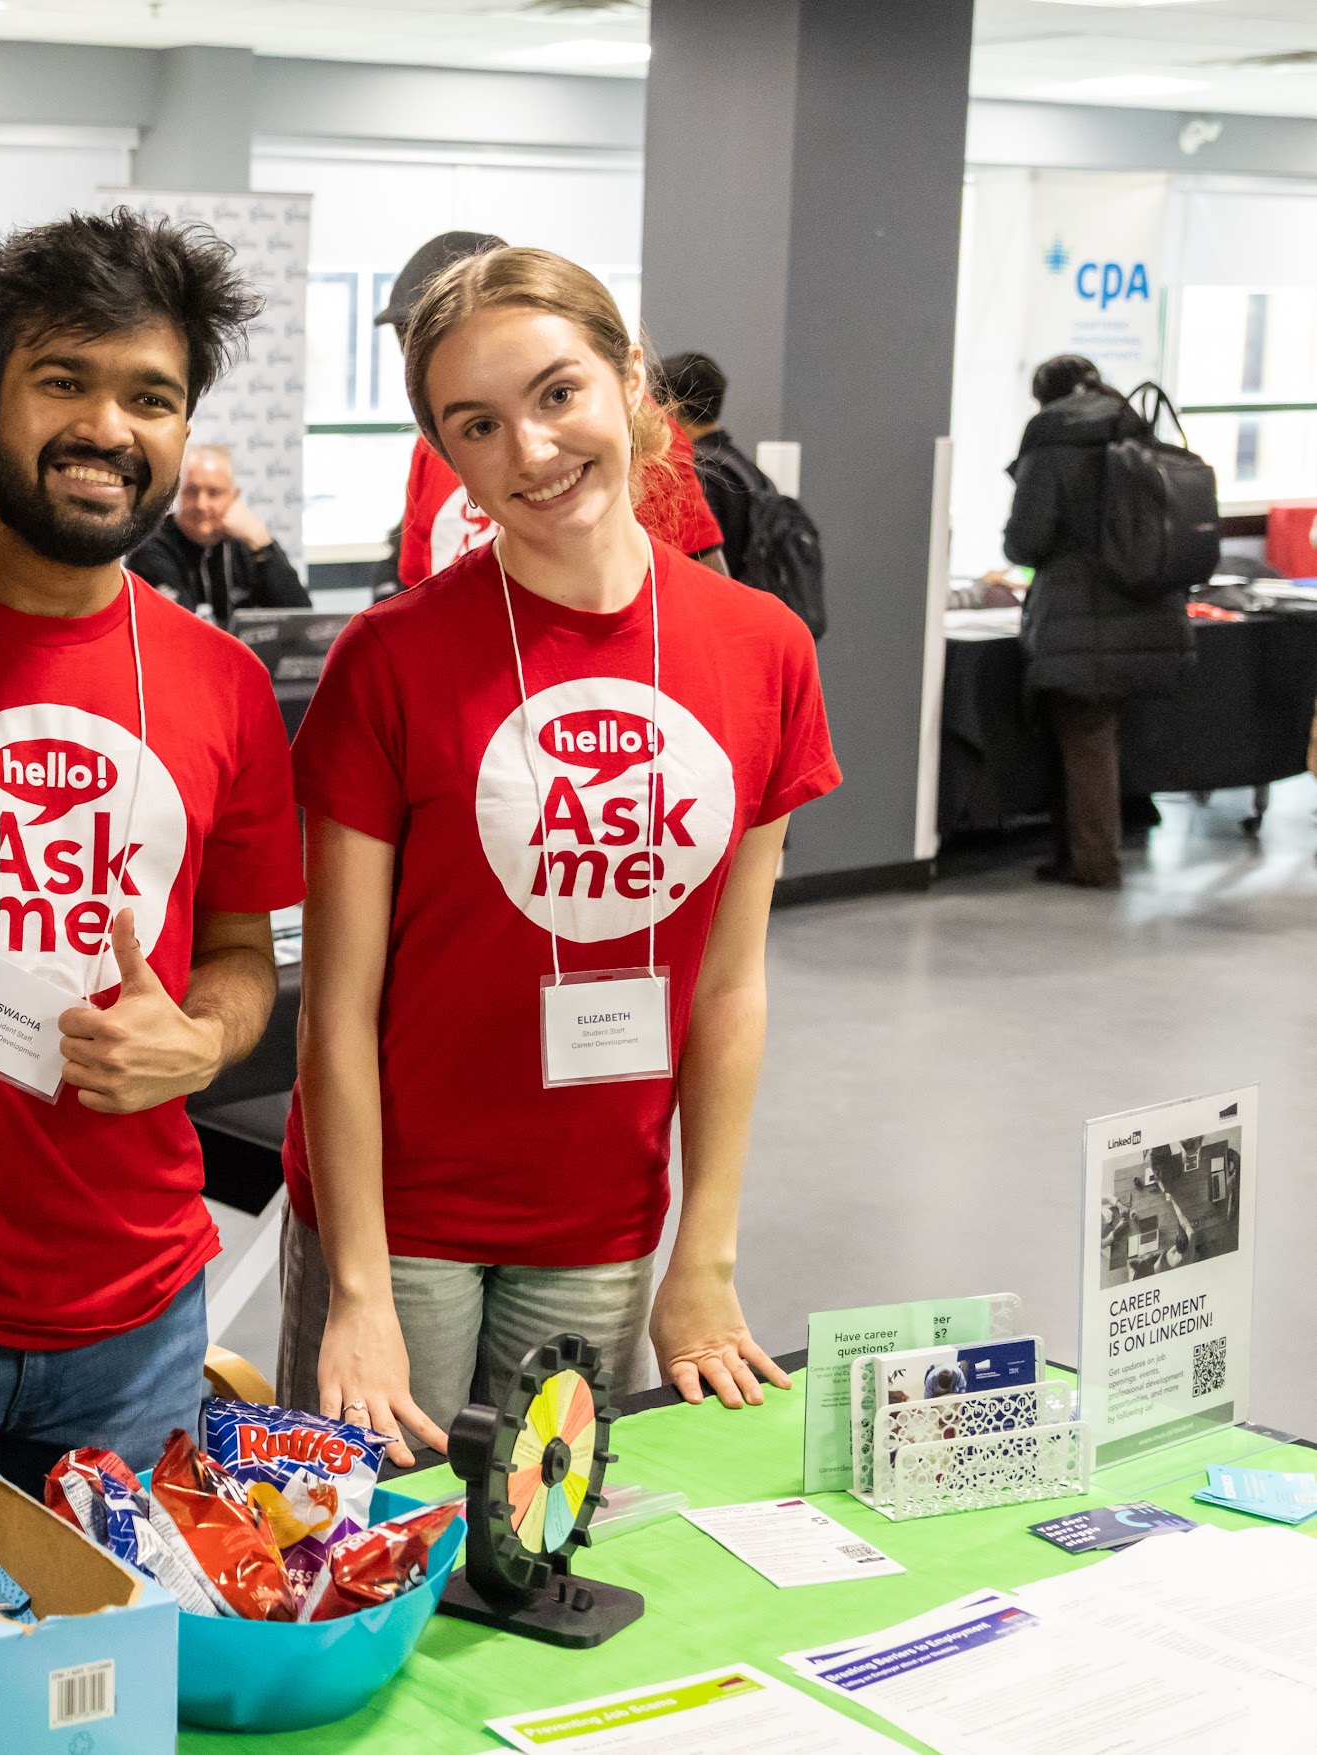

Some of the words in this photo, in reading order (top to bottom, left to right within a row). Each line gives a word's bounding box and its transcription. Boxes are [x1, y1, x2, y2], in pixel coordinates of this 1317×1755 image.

[552, 720, 656, 753] hello!
[2, 748, 108, 789] hello!
[528, 772, 698, 847] Ask
[530, 850, 686, 900] me.
[577, 1012, 631, 1025] ELIZABETH
[571, 1041, 594, 1049] Career
[595, 1037, 638, 1047] Development
[582, 1029, 608, 1037] Student
[1109, 1289, 1161, 1317] CAREER
[1109, 1294, 1207, 1338] DEVELOPMENT
[834, 1331, 861, 1343] Have
[864, 1329, 898, 1340] career
[1109, 1340, 1120, 1357] IS
[1124, 1332, 1146, 1352] ON
[1149, 1312, 1213, 1345] LINKEDIN!
[837, 1342, 895, 1358] questions?
[1108, 1367, 1120, 1377] Get
[1121, 1361, 1146, 1374] updates
[1146, 1357, 1155, 1365] on
[1155, 1353, 1166, 1365] job
[1108, 1382, 1145, 1403] professional
[1145, 1371, 1184, 1389] development
[1150, 1388, 1163, 1398] and
[1163, 1384, 1179, 1394] more
[1107, 1416, 1116, 1424] by
[1116, 1407, 1144, 1420] following
[236, 1424, 366, 1476] Ruffles
[1036, 1524, 1060, 1533] You
[1061, 1516, 1090, 1526] don't
[1045, 1527, 1074, 1537] have
[1056, 1526, 1101, 1542] struggle
[1065, 1535, 1096, 1547] alone
[825, 1661, 878, 1683] Breaking
[872, 1648, 917, 1667] Barriers
[913, 1643, 928, 1653] to
[926, 1622, 992, 1649] Employment
[523, 1715, 603, 1737] Preventing
[602, 1709, 630, 1721] Job
[628, 1698, 678, 1714] Scams
